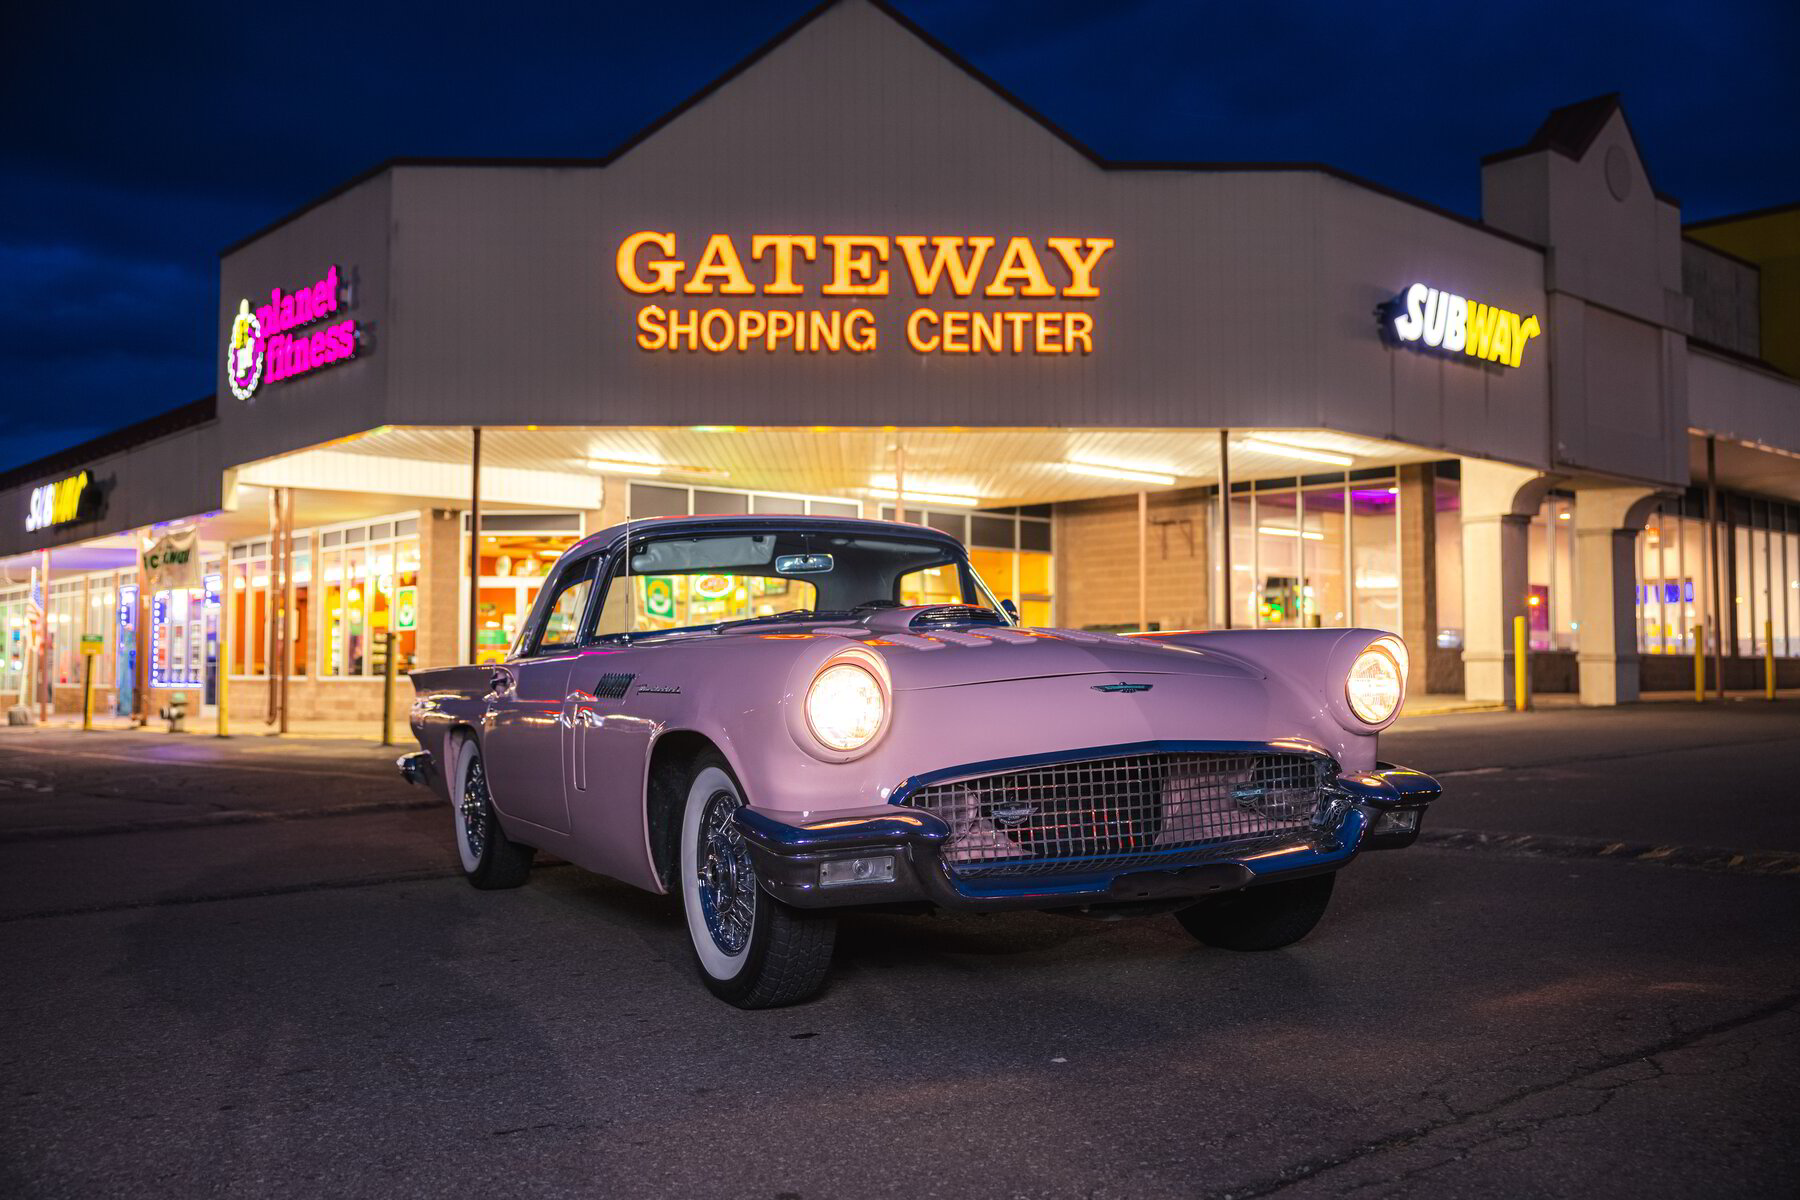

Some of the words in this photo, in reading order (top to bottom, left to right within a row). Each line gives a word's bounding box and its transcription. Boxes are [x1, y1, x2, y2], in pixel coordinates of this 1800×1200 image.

[616, 231, 1115, 297] GATEWAY
[256, 265, 337, 352] planet
[636, 305, 877, 352] SHOPPING
[906, 307, 1094, 353] CENTER
[1394, 283, 1541, 368] SUBWAY
[264, 320, 354, 384] fitness
